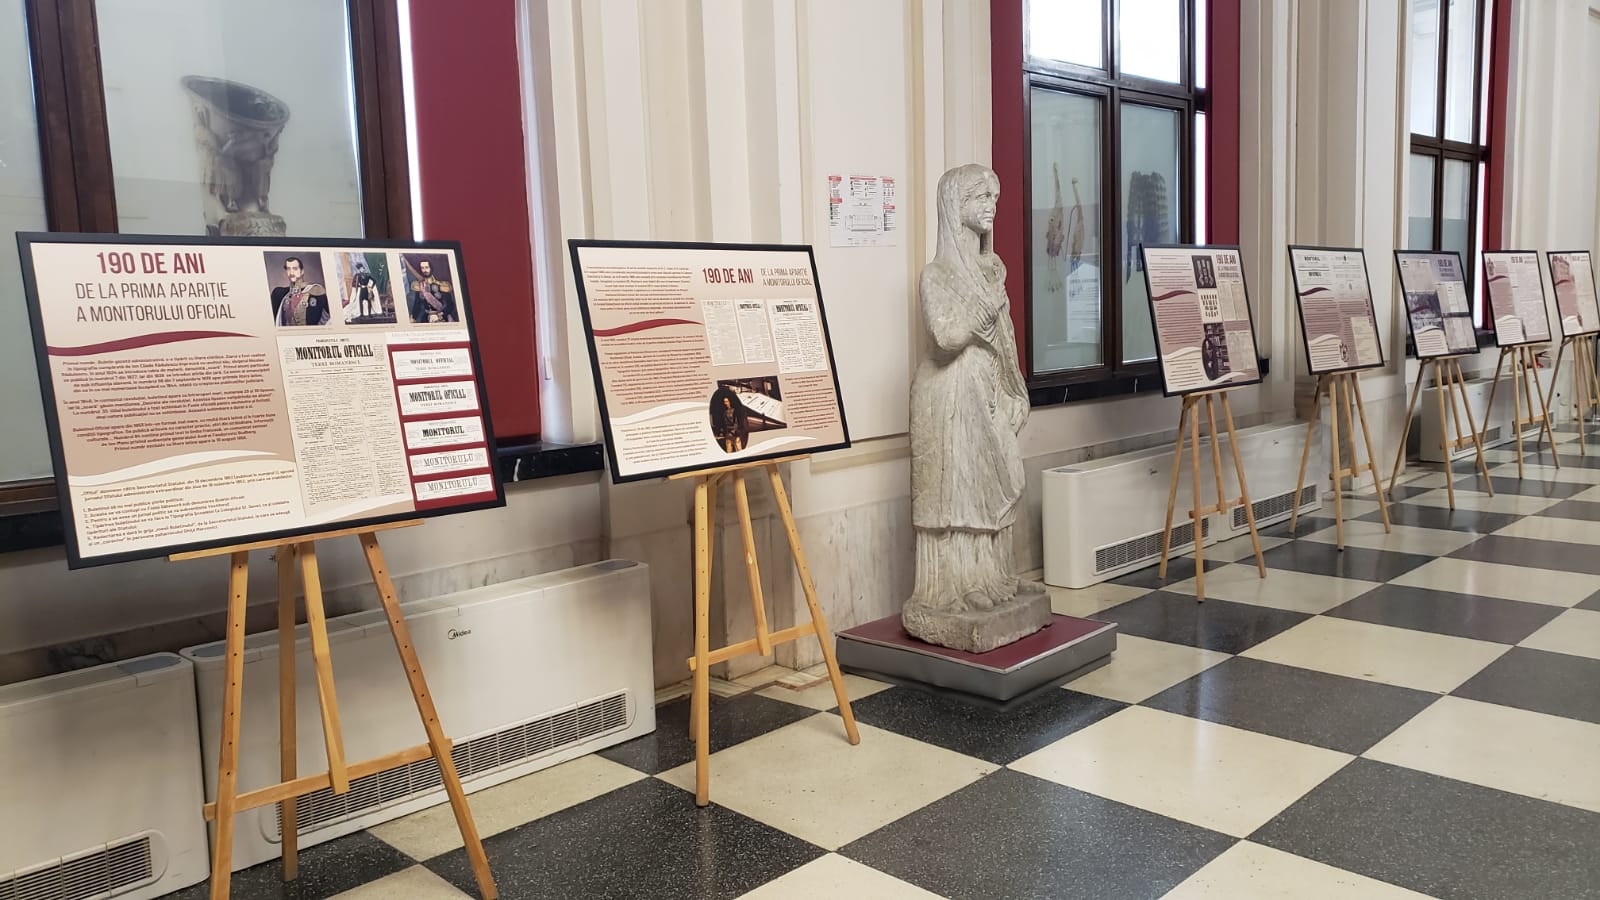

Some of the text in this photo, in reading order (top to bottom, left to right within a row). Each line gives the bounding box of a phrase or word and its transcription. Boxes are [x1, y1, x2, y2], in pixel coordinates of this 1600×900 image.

[97, 252, 206, 274] 190 DE ANI
[703, 268, 754, 284] 190 DE ANI
[75, 282, 229, 300] DE LA PRIMA APARIȚIE
[77, 304, 236, 322] A MONITORULUI OFICIAL
[295, 344, 374, 360] MONITORUL OFICIAL
[409, 389, 466, 402] MONITORUL OFICIAL
[422, 426, 464, 437] MONITORUL
[452, 630, 472, 638] Midea
